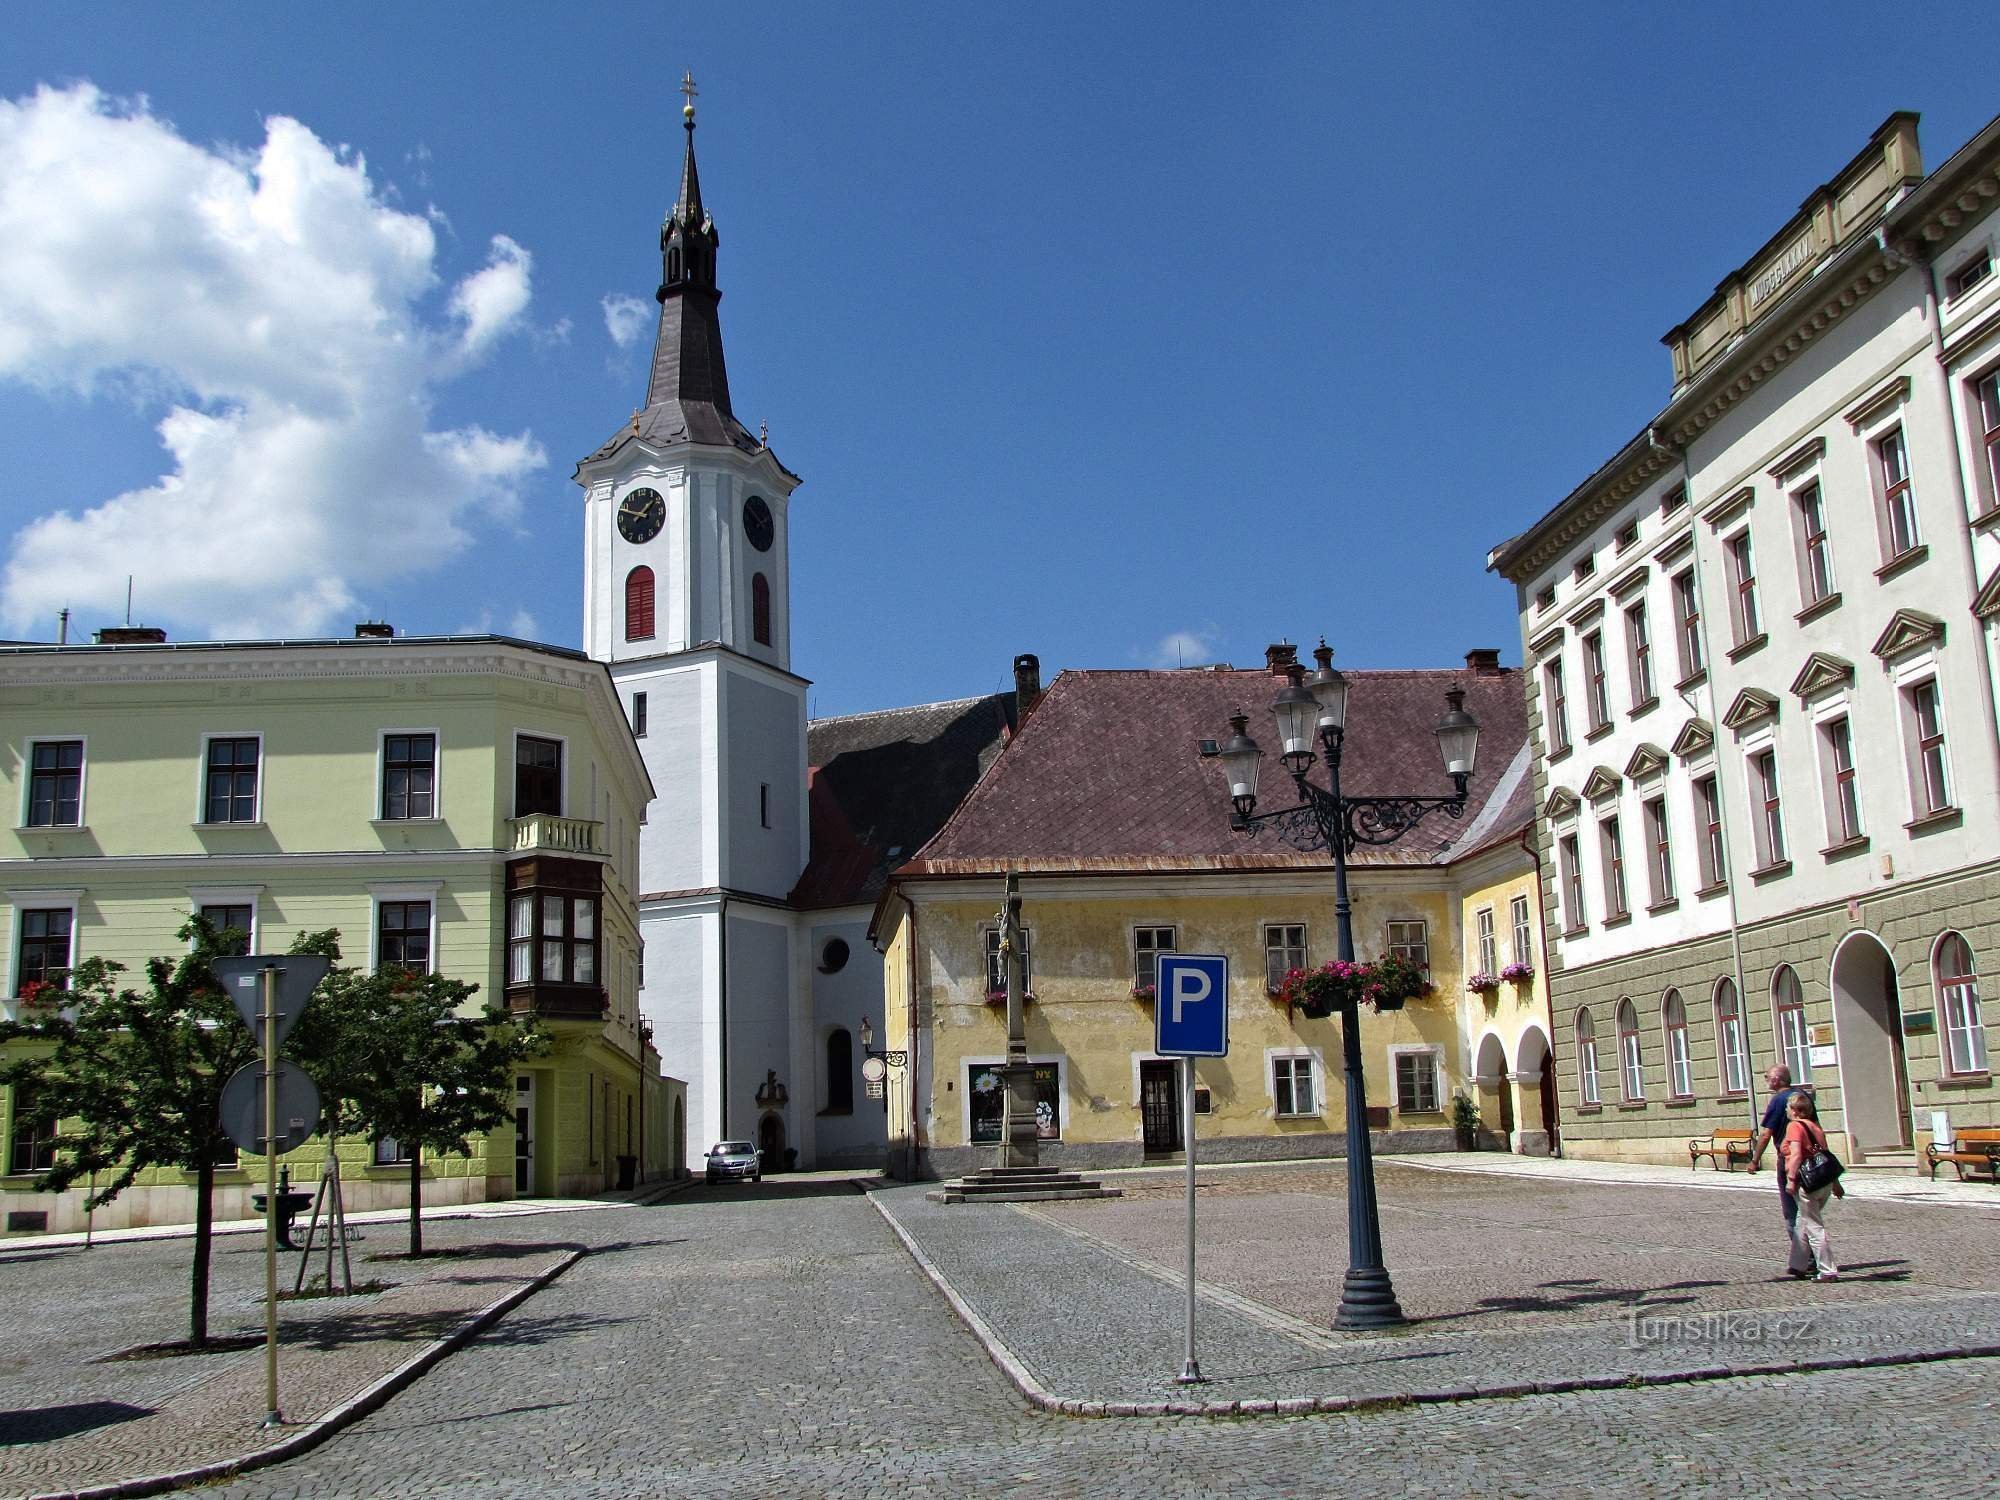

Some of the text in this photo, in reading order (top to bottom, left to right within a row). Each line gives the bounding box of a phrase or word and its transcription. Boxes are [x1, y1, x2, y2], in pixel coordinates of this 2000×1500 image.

[628, 493, 634, 501] 11
[655, 496, 660, 504] 2
[1173, 968, 1211, 1022] P
